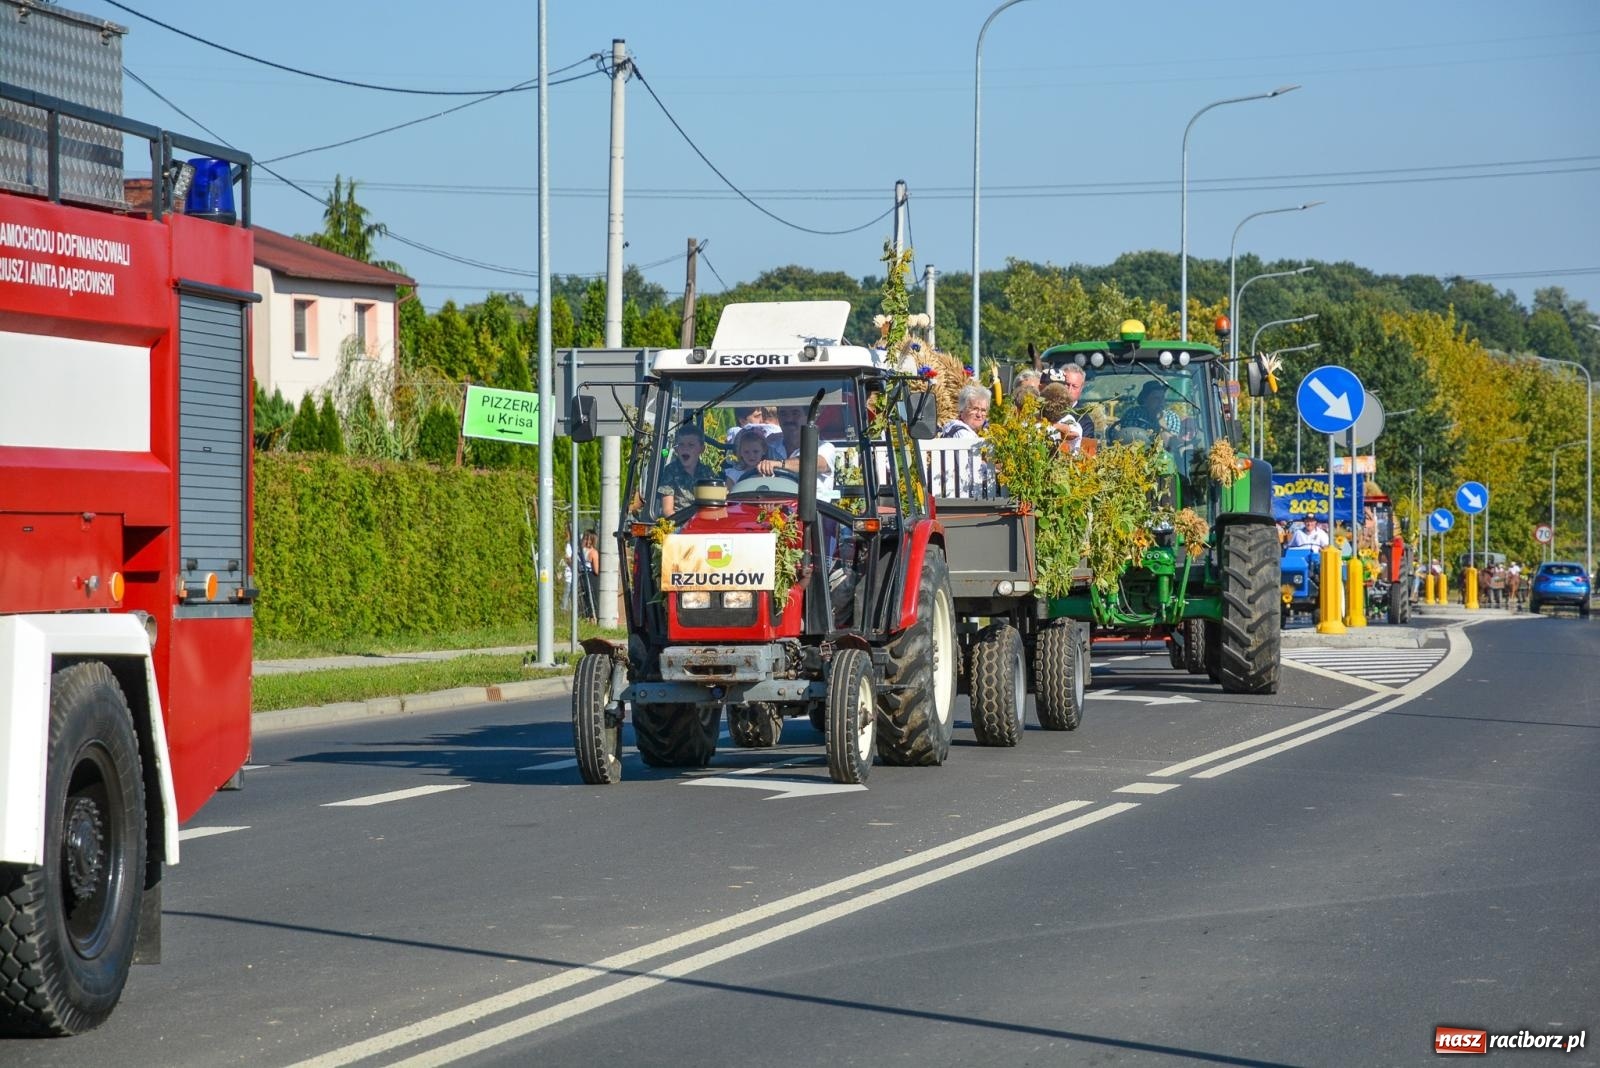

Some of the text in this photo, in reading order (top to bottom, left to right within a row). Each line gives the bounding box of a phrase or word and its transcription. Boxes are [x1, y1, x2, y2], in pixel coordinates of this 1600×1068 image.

[0, 222, 130, 266] AMOCHODU DOFINANSOWALI
[25, 260, 29, 284] I
[30, 262, 58, 289] ANITA
[59, 266, 115, 297] DĄBROWSKI
[719, 354, 790, 366] ESCORT
[481, 395, 541, 414] PIZZERIA
[487, 412, 533, 428] u Krisa
[1289, 499, 1329, 514] 2023
[1539, 530, 1551, 539] 70
[671, 570, 765, 586] RZUCHÓW
